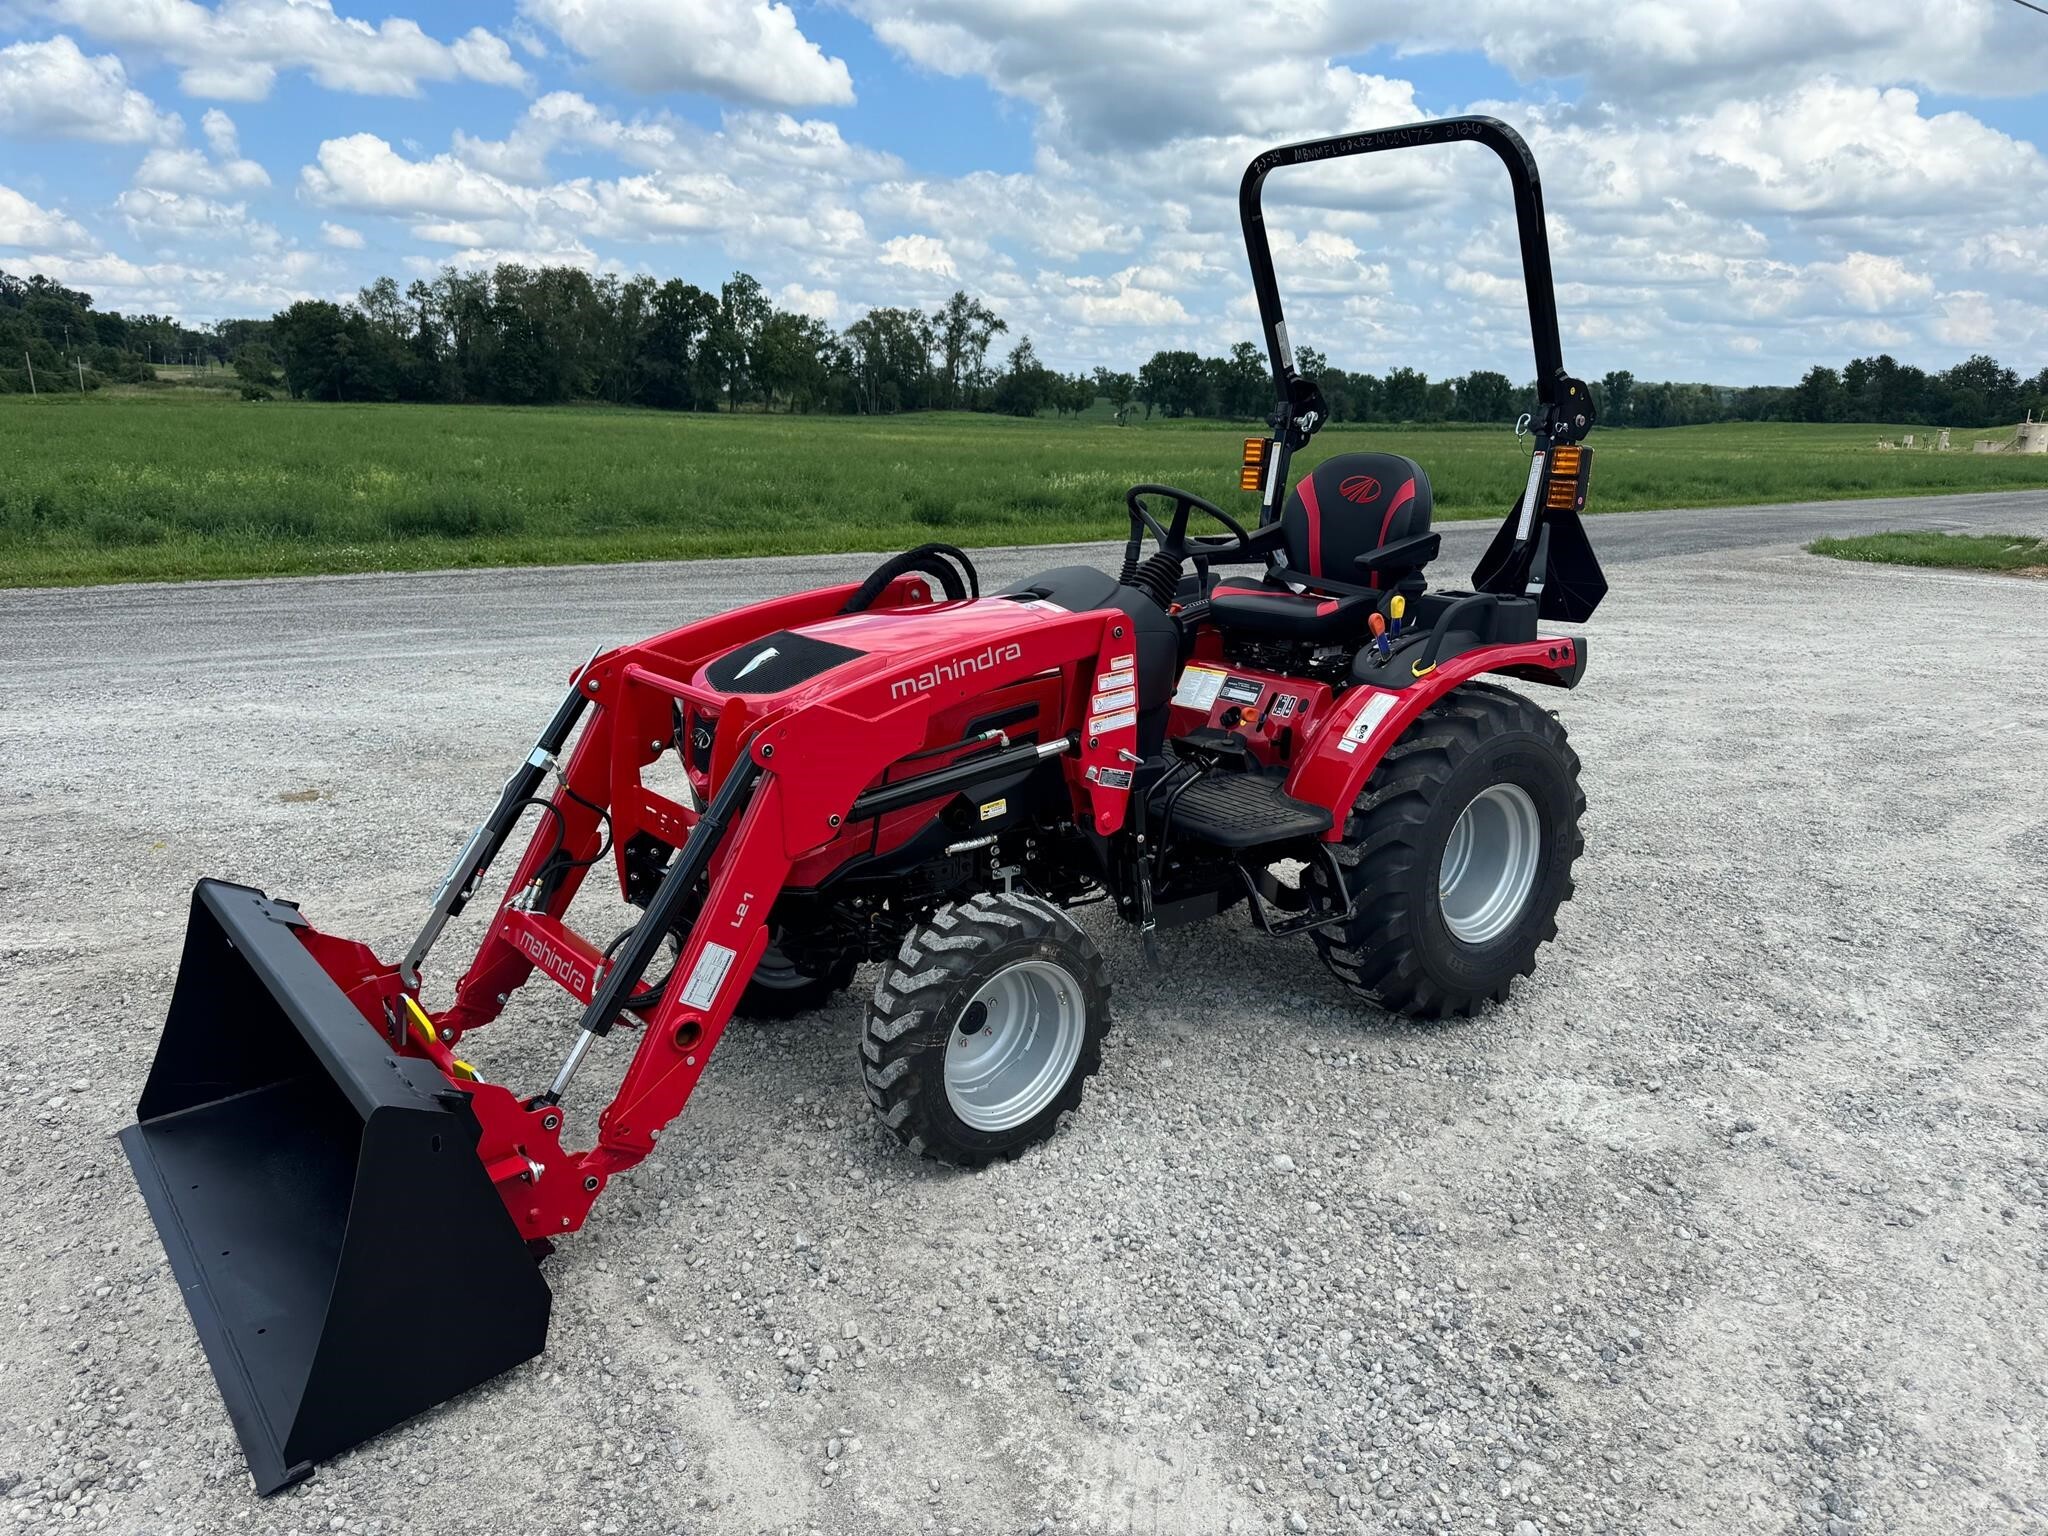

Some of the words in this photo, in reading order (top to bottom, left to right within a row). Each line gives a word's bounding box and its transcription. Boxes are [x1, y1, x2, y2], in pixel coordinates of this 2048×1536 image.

[891, 642, 1021, 700] mahindra
[730, 891, 754, 928] L21
[520, 931, 586, 992] mahindra
